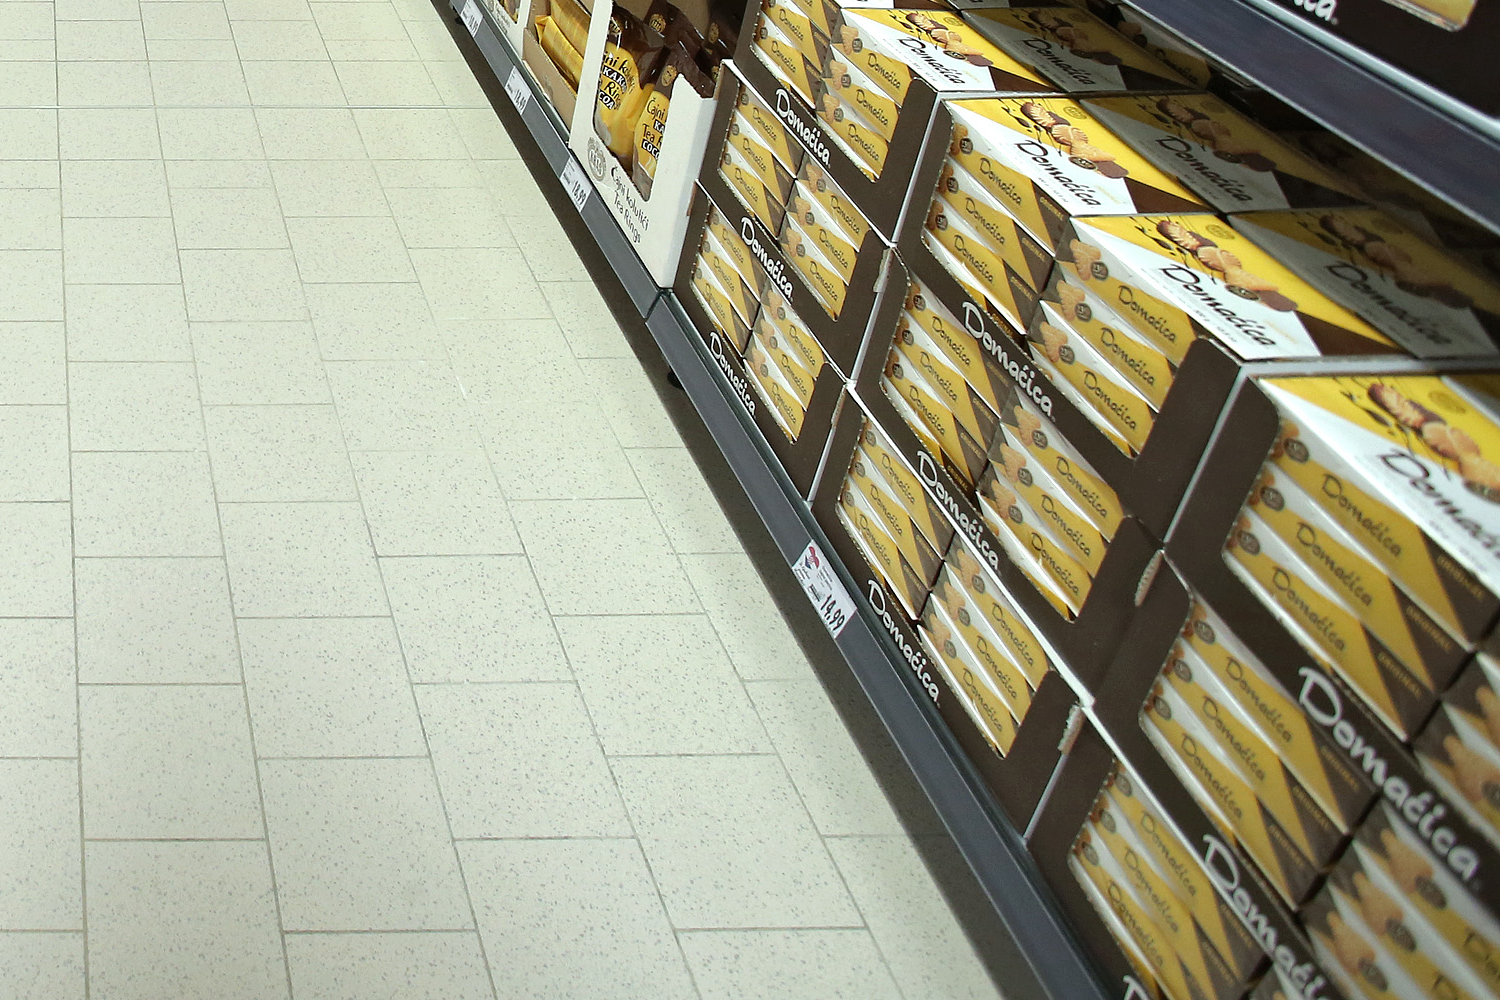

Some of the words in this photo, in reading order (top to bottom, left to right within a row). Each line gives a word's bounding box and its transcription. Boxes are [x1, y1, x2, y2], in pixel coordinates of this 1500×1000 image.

[899, 36, 966, 87] Domaćica
[1023, 36, 1096, 87] Domaćica
[643, 123, 655, 143] Tea
[776, 89, 830, 166] Domaćica
[1014, 138, 1102, 209] Domaćica
[741, 217, 793, 301] Domaćica
[1117, 284, 1177, 345] Domaćica
[1159, 263, 1277, 348] Domaćica
[710, 332, 755, 416] Domaćica
[962, 303, 1053, 415] Domaćica
[917, 451, 999, 570] Domaćica
[1323, 474, 1401, 557] Domaćica
[819, 595, 846, 635] 14.99
[868, 580, 941, 702] Domaćica
[1300, 666, 1479, 879] Domaćica
